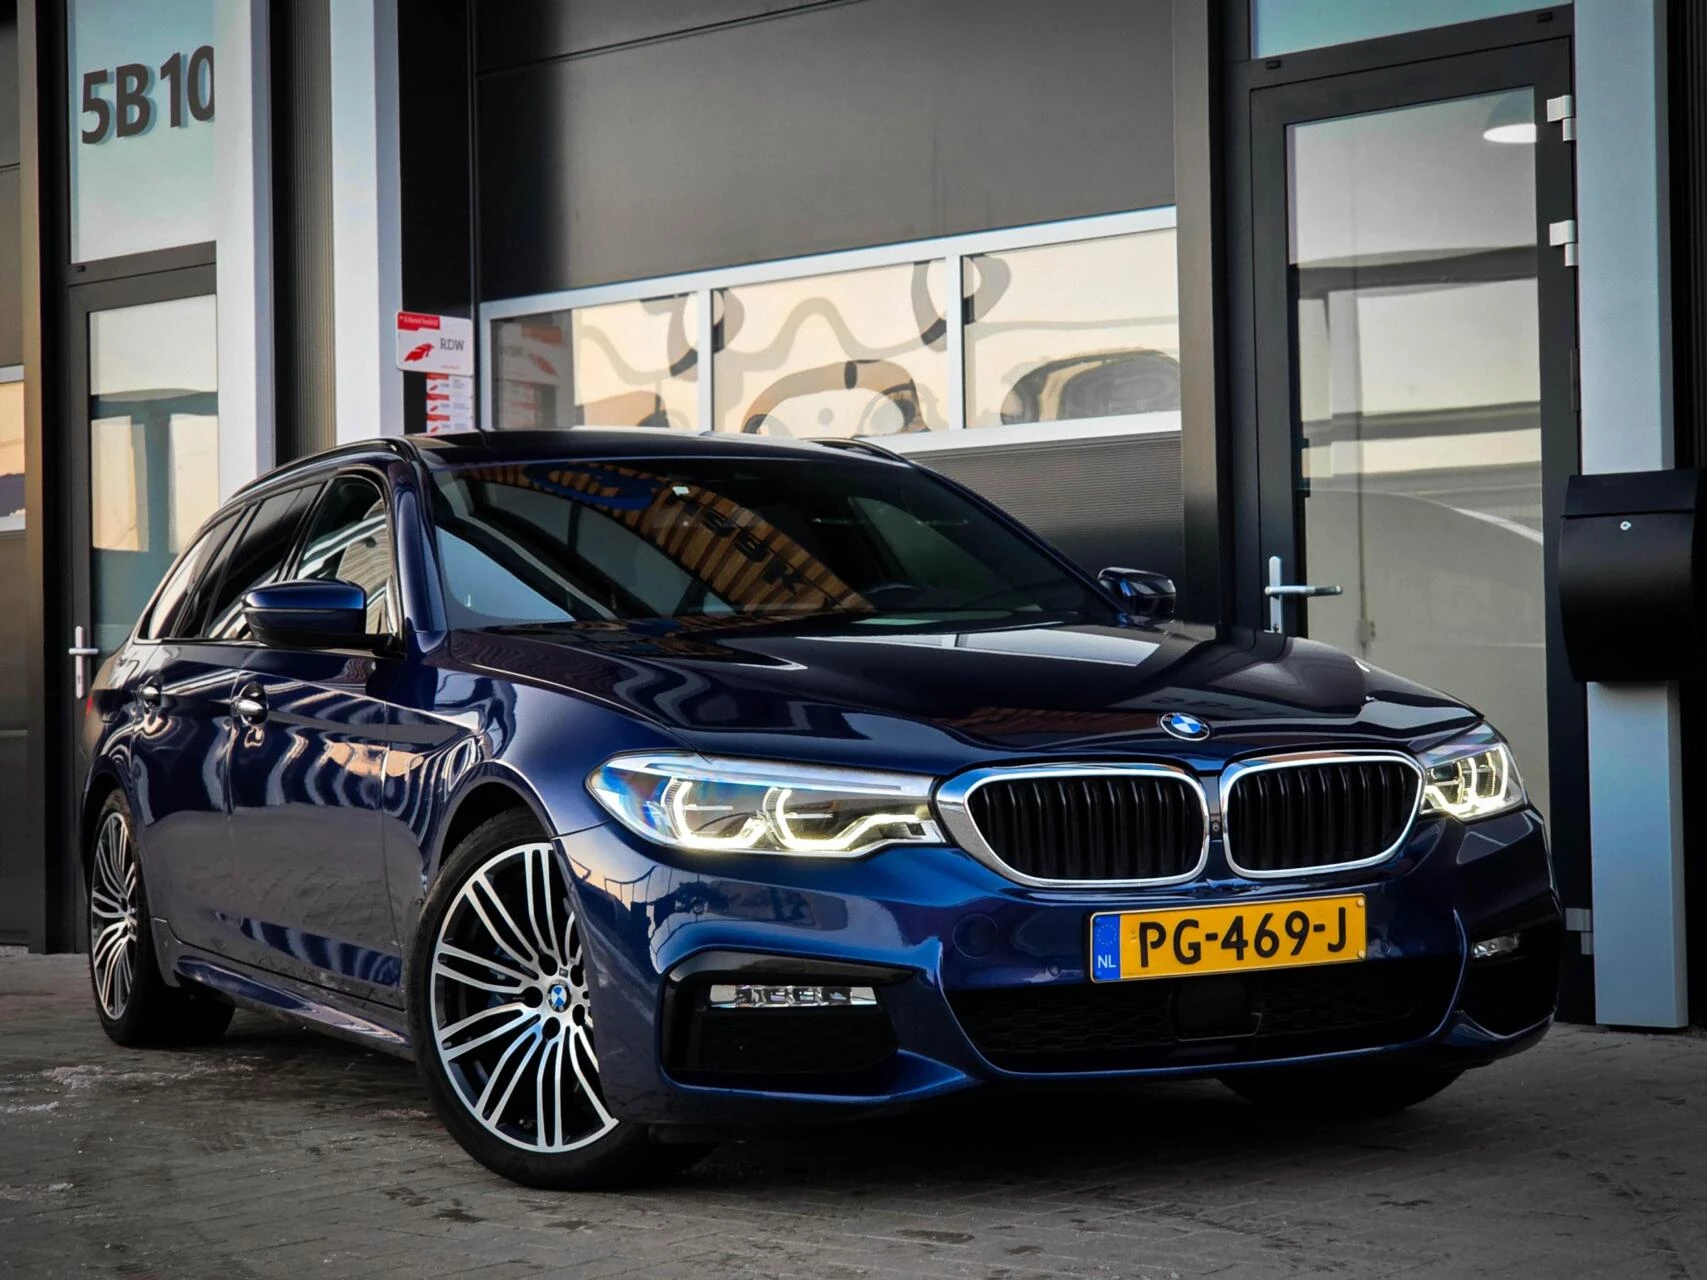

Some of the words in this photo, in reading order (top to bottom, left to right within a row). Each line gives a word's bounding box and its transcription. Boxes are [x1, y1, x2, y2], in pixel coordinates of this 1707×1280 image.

[82, 45, 215, 144] 5B10
[440, 338, 464, 351] RDW
[1138, 907, 1347, 968] PG-469-J
[1098, 954, 1117, 969] NL
